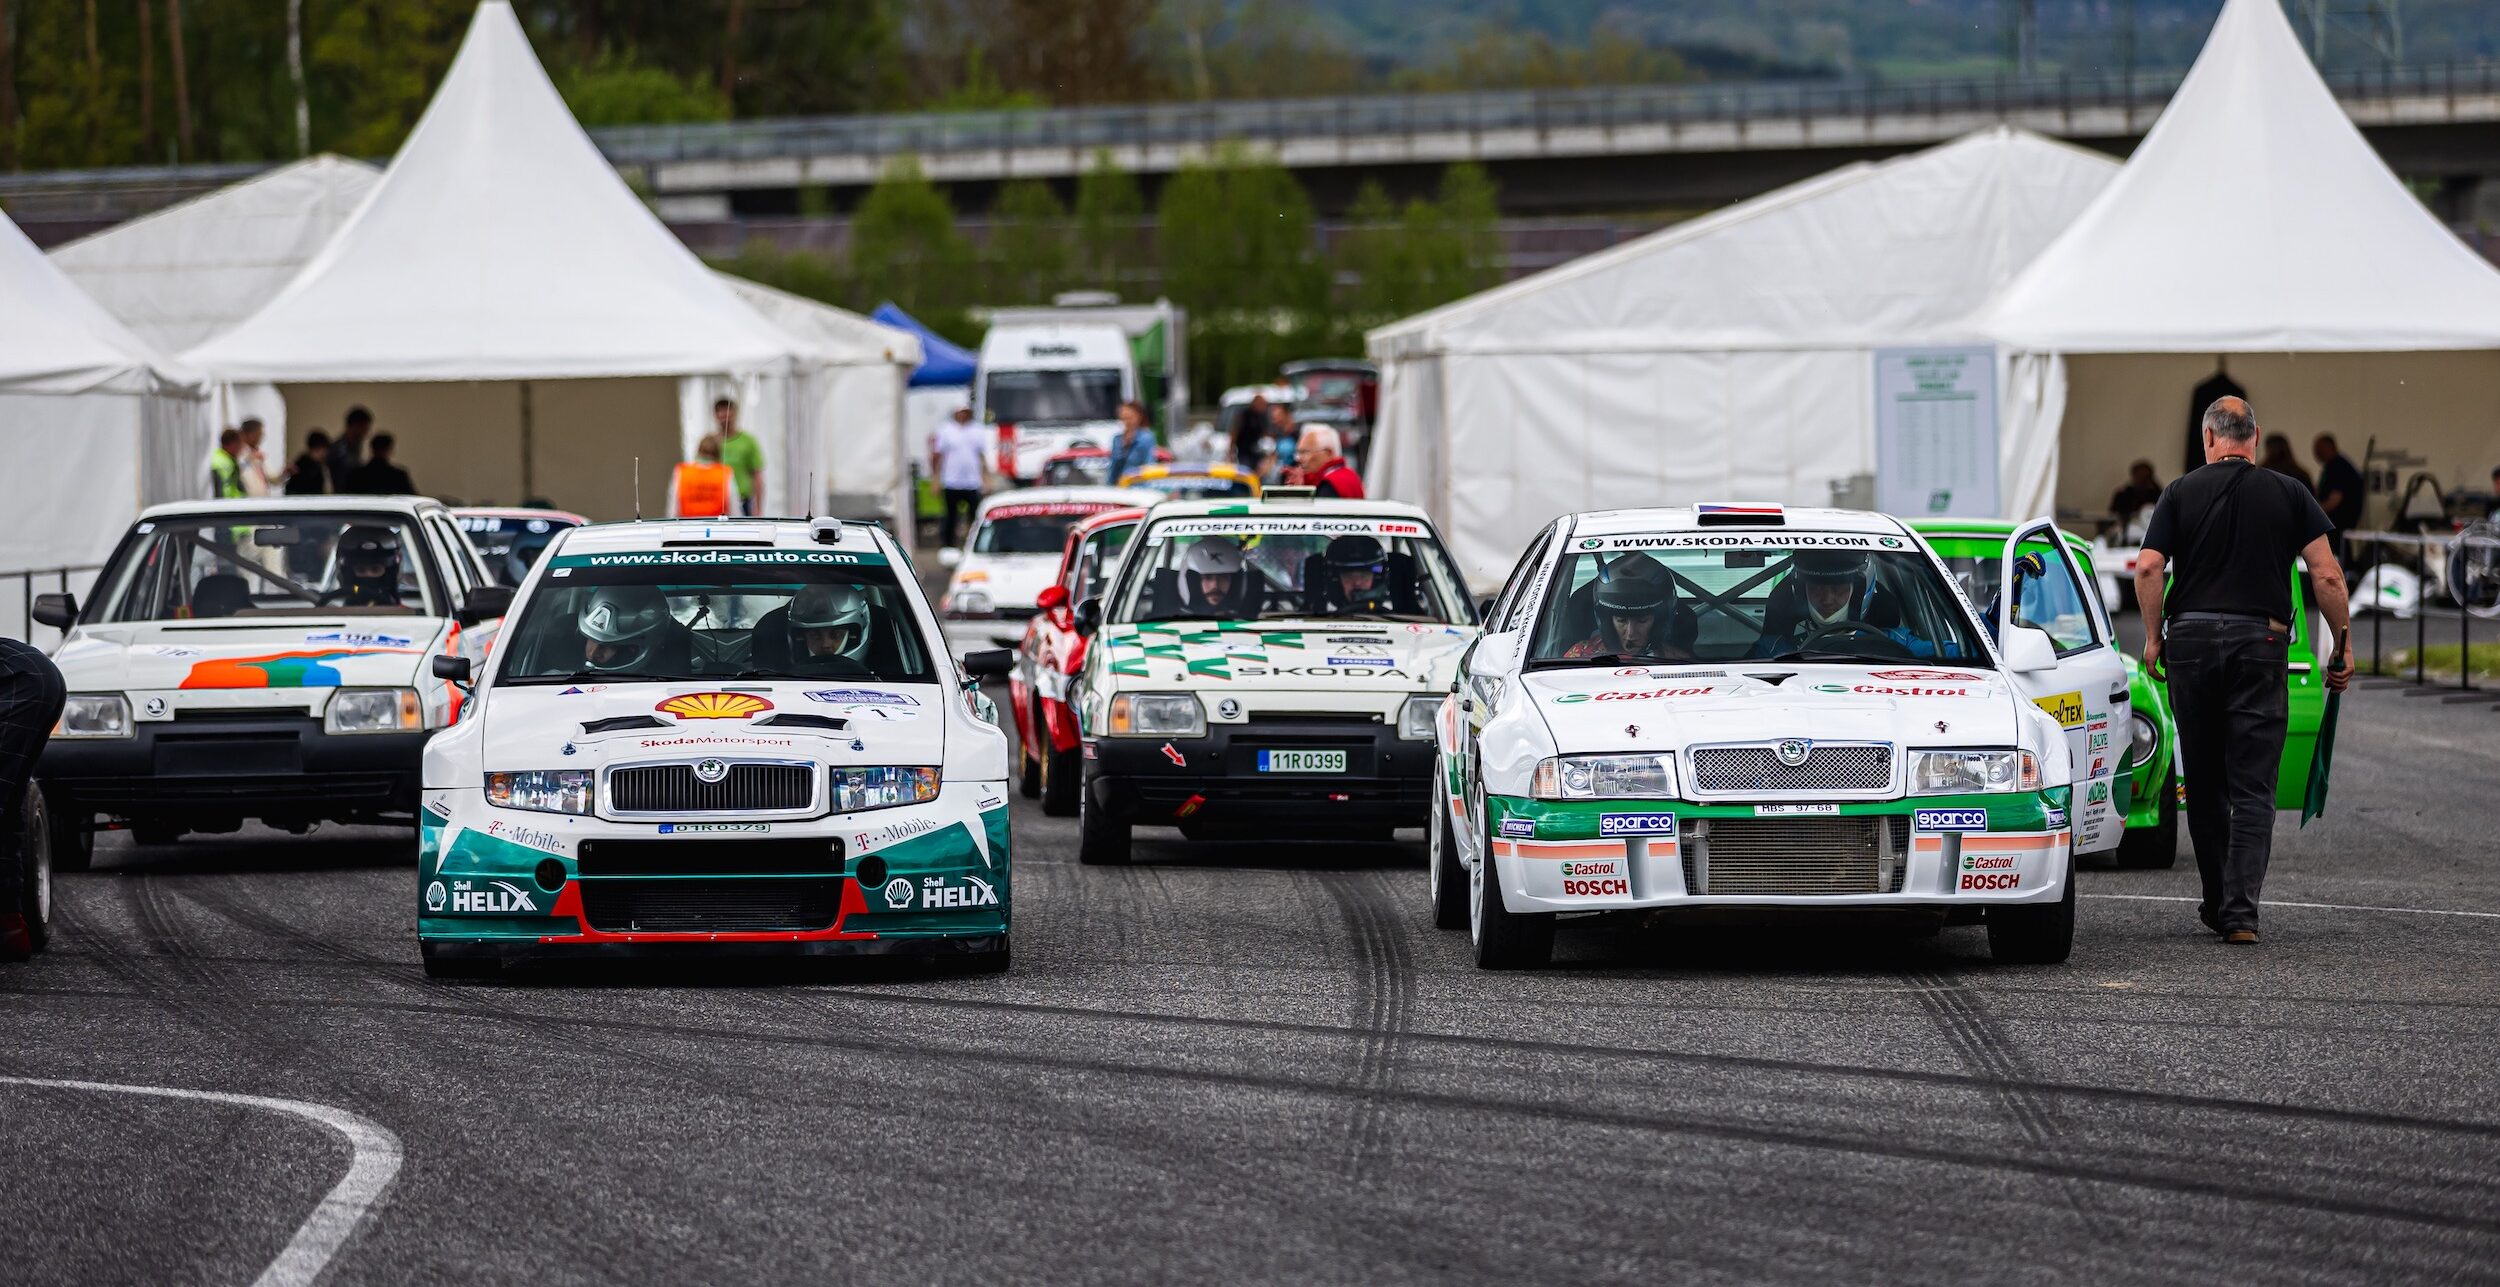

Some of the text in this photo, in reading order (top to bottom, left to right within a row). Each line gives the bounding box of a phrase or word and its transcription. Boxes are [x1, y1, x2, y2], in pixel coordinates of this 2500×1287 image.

[1163, 521, 1418, 534] AUTOSPEKTRUM ŠKODA team
[1613, 536, 1871, 547] WWW.SKODA-AUTO.COM
[590, 551, 859, 565] www.skoda-auto.com
[1594, 687, 1714, 701] Castrol
[1854, 685, 1969, 696] Castrol
[1273, 753, 1343, 769] 11R 0399
[1762, 804, 1832, 812] MBS 97-68
[1505, 820, 1533, 832] MICHELIN
[1602, 816, 1671, 833] sparco
[1918, 811, 1985, 829] sparco
[1574, 862, 1615, 876] Castrol
[1974, 856, 2014, 869] Castrol
[453, 880, 472, 890] Shell
[924, 877, 944, 887] Shell
[1564, 879, 1628, 895] BOSCH
[1961, 873, 2020, 889] BOSCH
[453, 888, 537, 911] HELIX
[922, 885, 999, 908] HELIX
